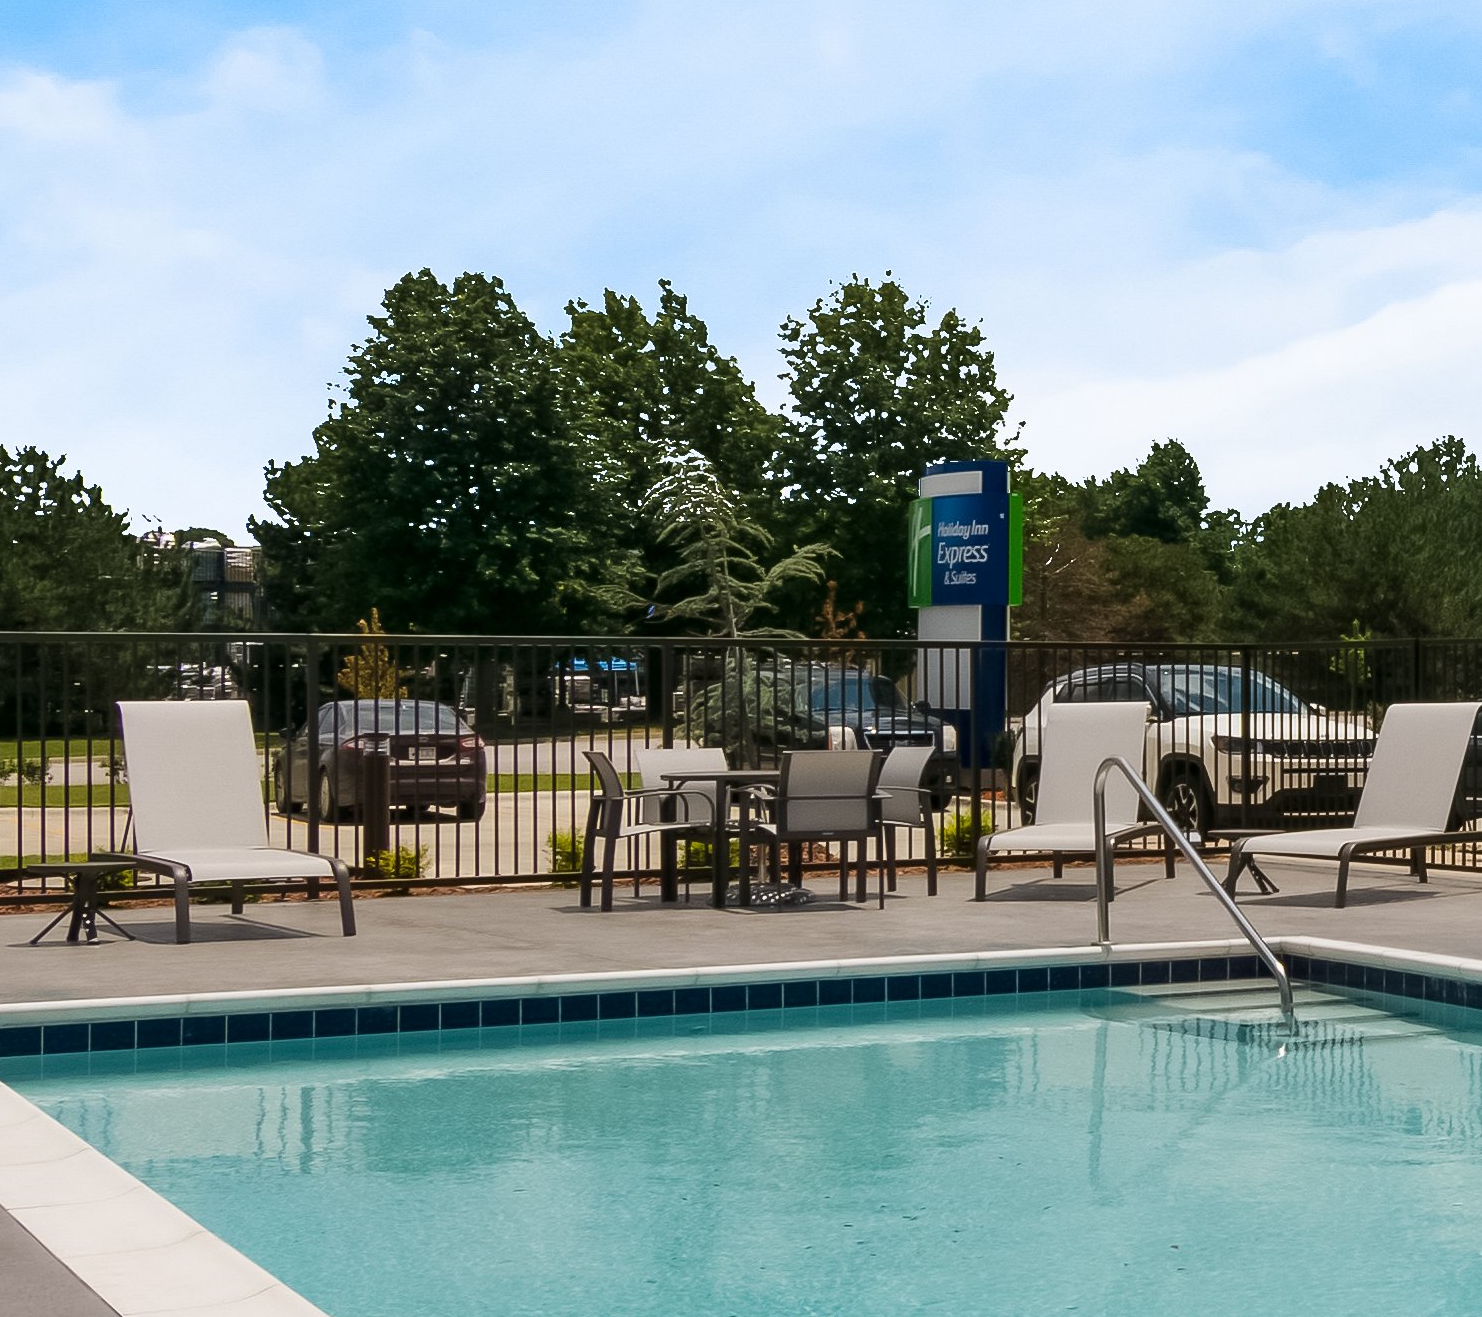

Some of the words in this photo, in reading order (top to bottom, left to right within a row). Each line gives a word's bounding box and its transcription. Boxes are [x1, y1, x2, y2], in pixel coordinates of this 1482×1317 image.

[937, 521, 970, 539] Holiday
[971, 519, 988, 535] Inn
[937, 542, 988, 569] Express
[944, 571, 950, 585] &
[950, 570, 976, 584] Suites
